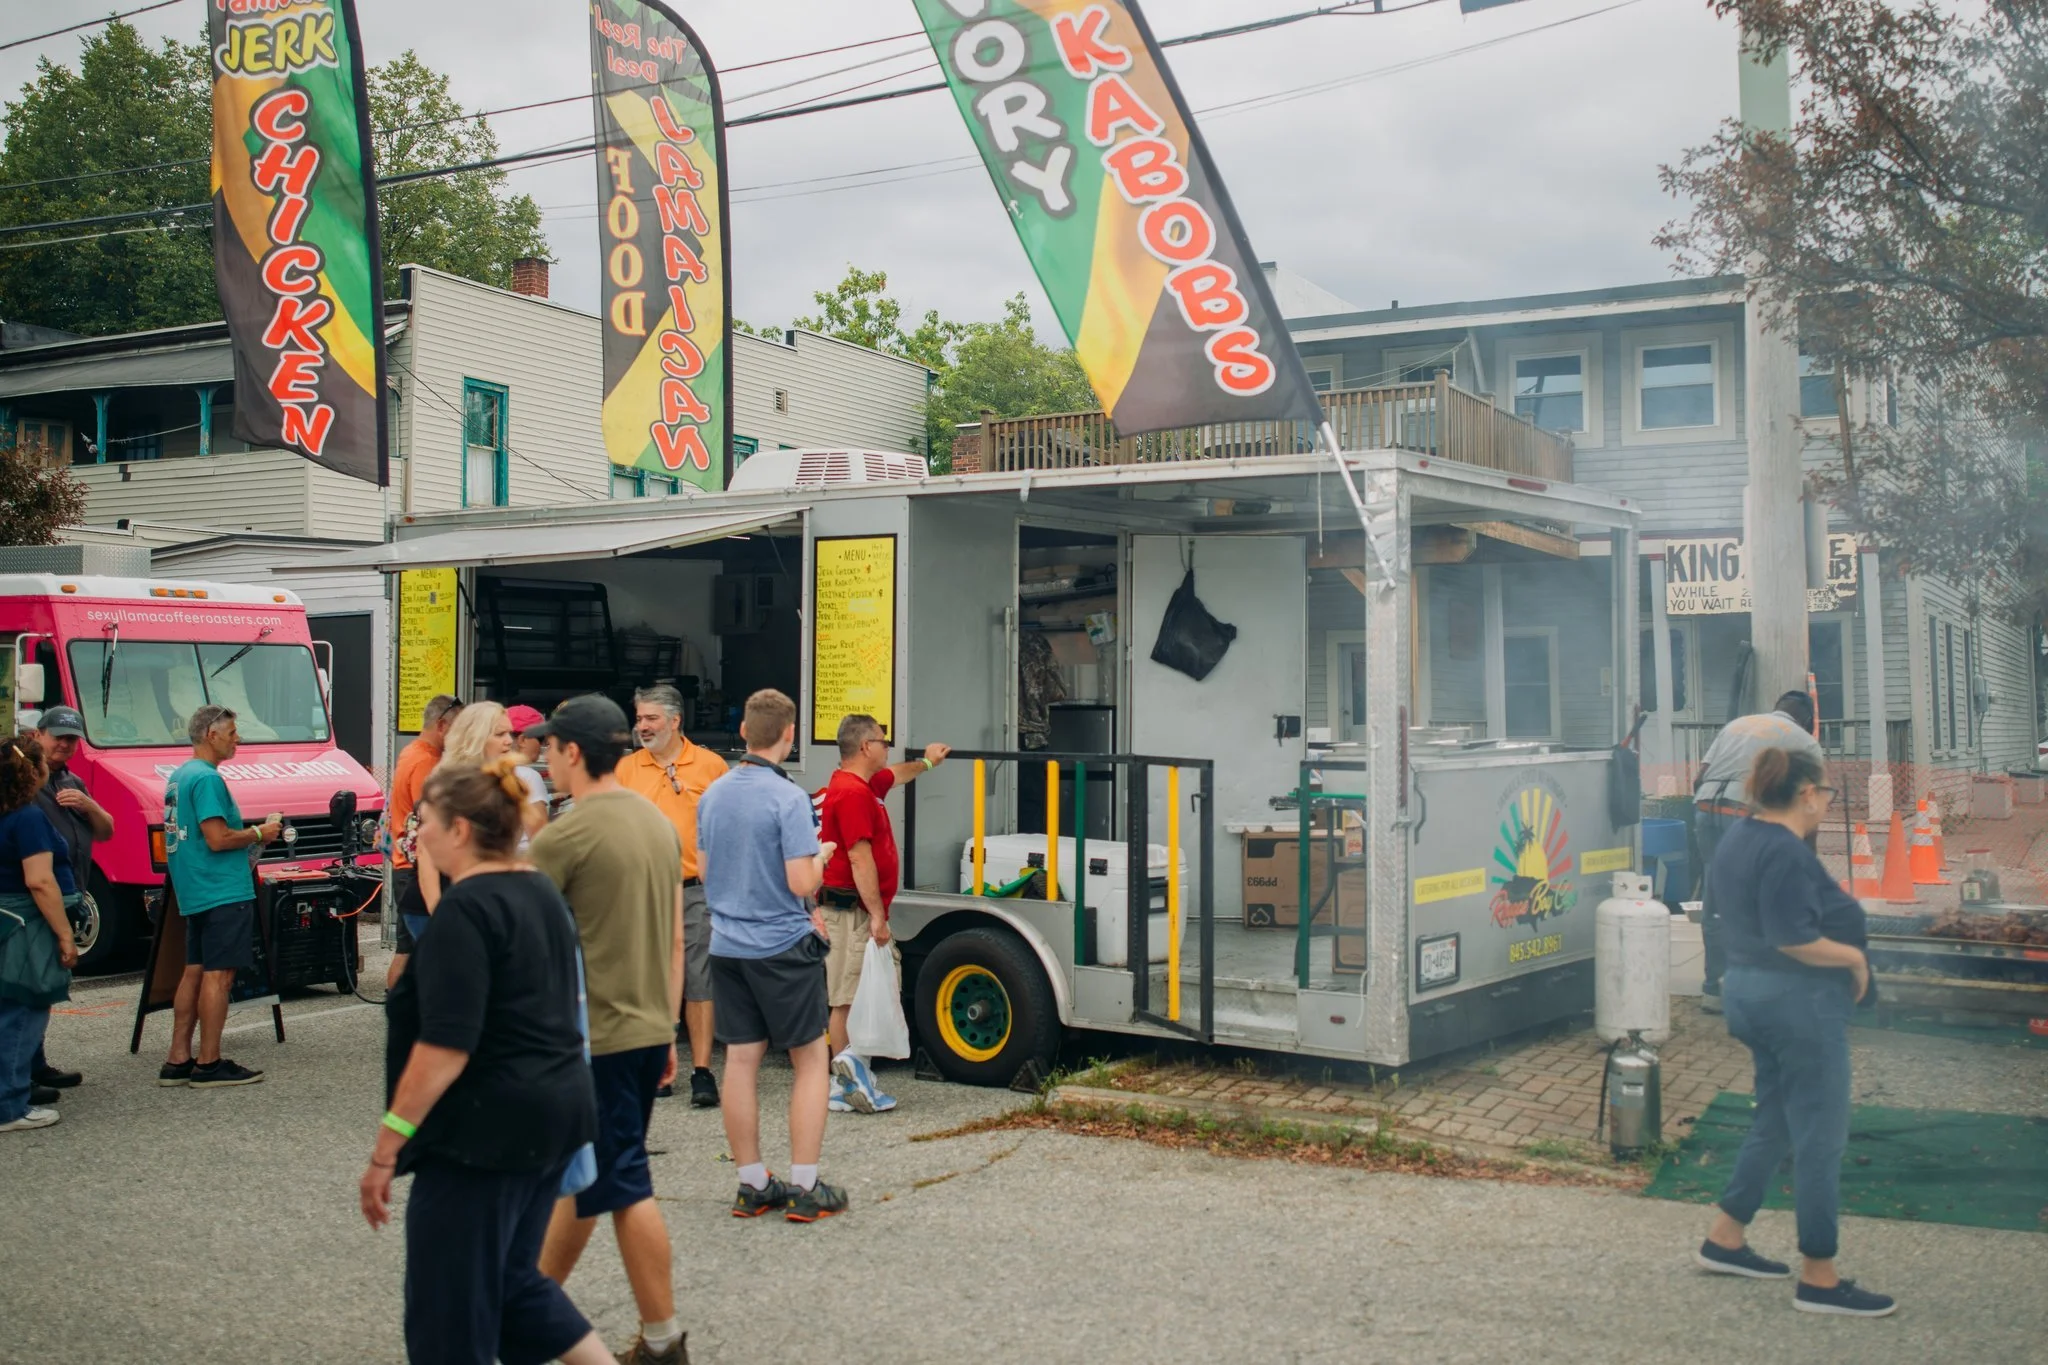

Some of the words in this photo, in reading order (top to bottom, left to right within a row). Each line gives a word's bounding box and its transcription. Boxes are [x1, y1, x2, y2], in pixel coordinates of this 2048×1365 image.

[222, 13, 338, 73] JERK
[1050, 4, 1276, 396] KABOBS
[254, 90, 335, 456] CHICKEN
[844, 549, 867, 561] MENU
[420, 568, 437, 579] MENU
[1672, 586, 1719, 599] WHILE
[1670, 599, 1695, 612] YOU
[1702, 597, 1735, 611] WAIT
[87, 608, 282, 626] sexyllamacoffeeroasters.com
[1247, 876, 1278, 888] PP993
